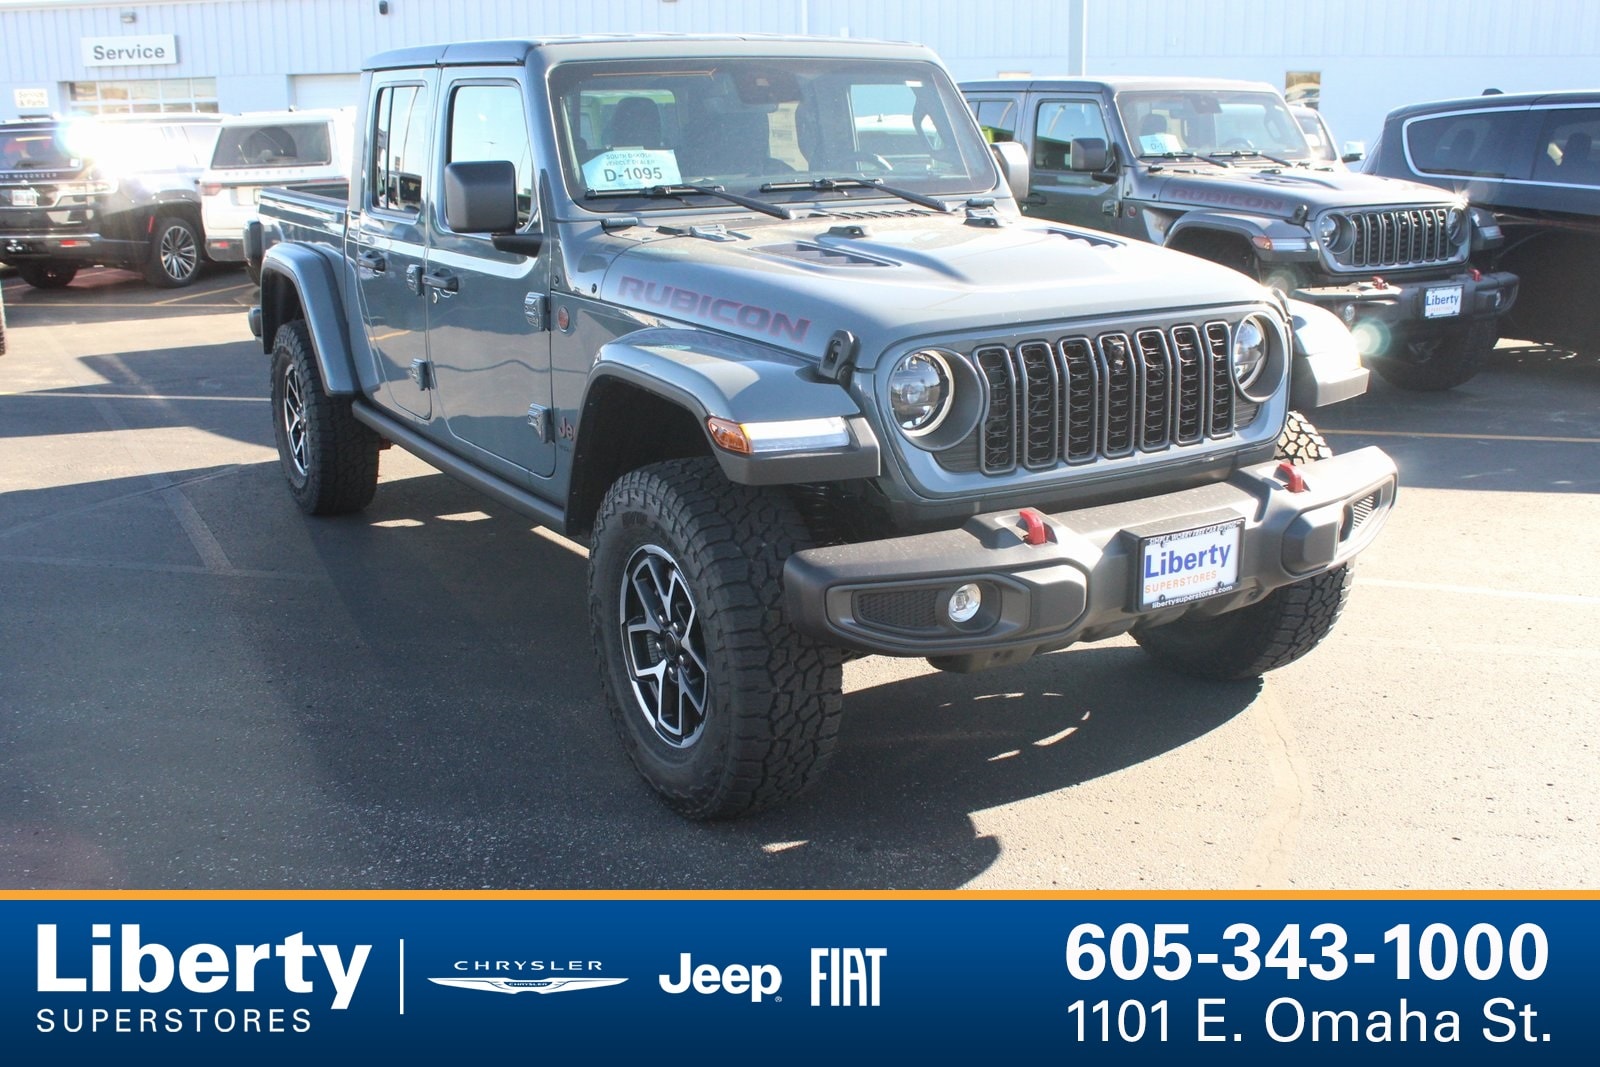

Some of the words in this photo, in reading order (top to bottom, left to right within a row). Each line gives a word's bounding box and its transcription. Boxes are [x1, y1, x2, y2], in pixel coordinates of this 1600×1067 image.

[93, 44, 165, 60] Service
[603, 167, 663, 182] D-1095
[1172, 188, 1284, 210] RUBICON
[616, 275, 812, 343] RUBICON
[1426, 295, 1459, 306] Liberty
[1145, 544, 1231, 578] Liberty
[1144, 570, 1217, 594] SUPERSTORES
[1151, 584, 1233, 609] libertysuperstores.com
